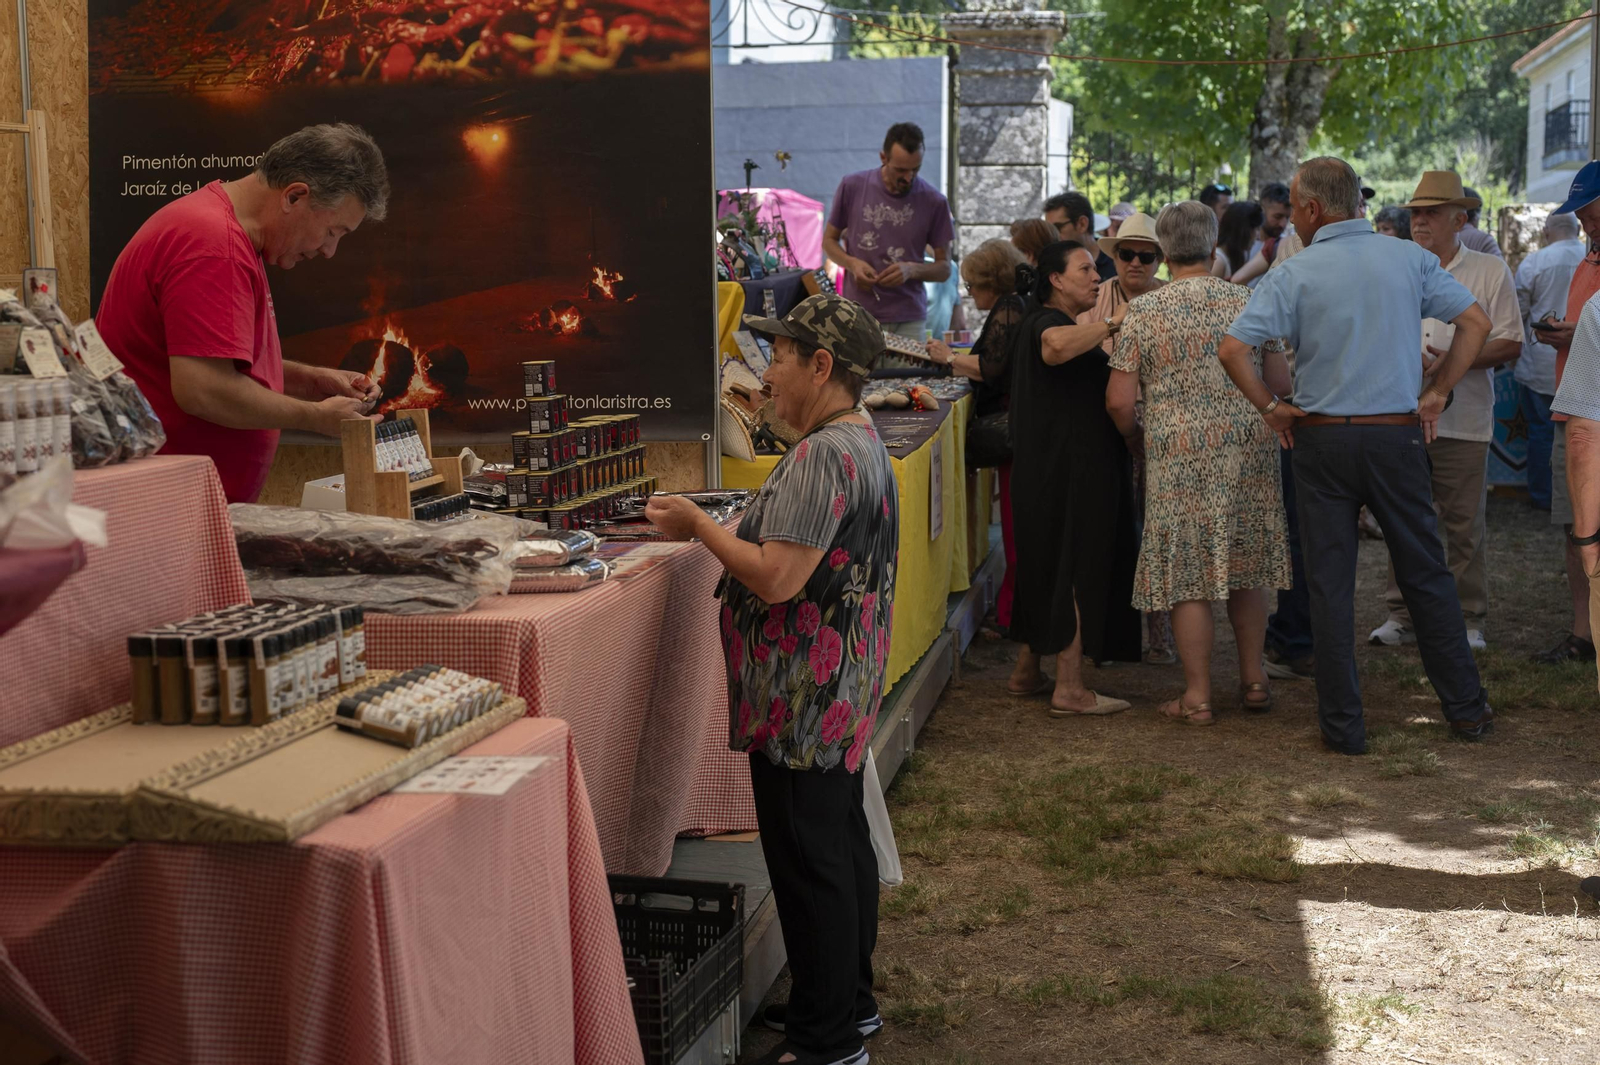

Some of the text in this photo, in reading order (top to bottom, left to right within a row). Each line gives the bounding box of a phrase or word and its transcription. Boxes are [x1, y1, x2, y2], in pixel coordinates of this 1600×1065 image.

[122, 152, 265, 170] Pimentón ahumad
[120, 180, 167, 196] Jaraíz
[171, 180, 192, 195] de
[467, 394, 672, 412] www.ptonlaristra.es
